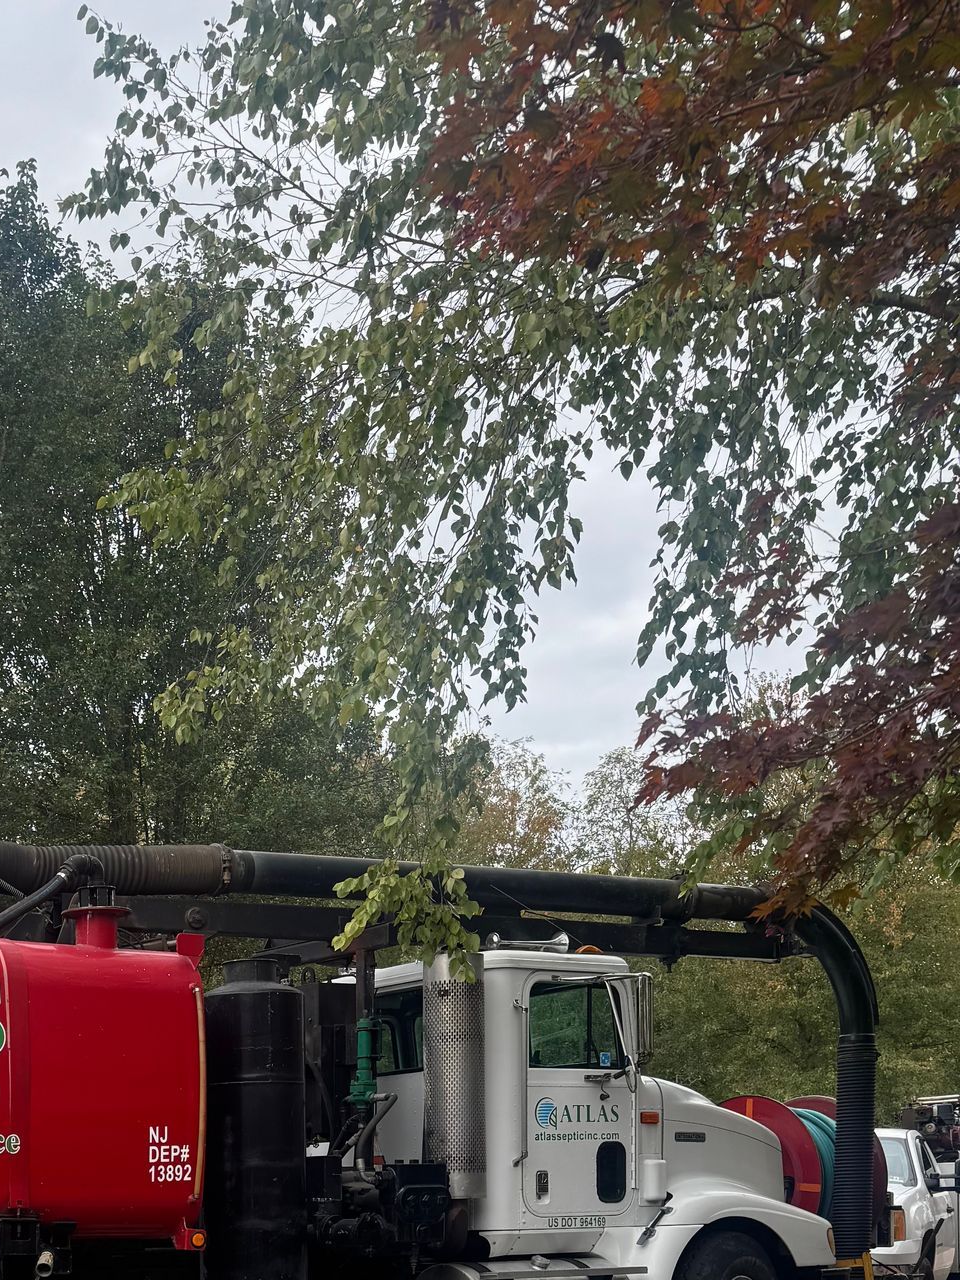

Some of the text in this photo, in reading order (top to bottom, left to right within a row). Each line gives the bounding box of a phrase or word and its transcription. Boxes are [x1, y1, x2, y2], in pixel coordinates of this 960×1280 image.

[560, 1104, 620, 1123] ATLAS
[149, 1126, 168, 1144] NJ
[534, 1131, 620, 1142] atlassepticinc.com
[148, 1145, 190, 1163] DEP#
[148, 1164, 192, 1182] 13892
[548, 1218, 559, 1228] US
[561, 1217, 577, 1228] DOT
